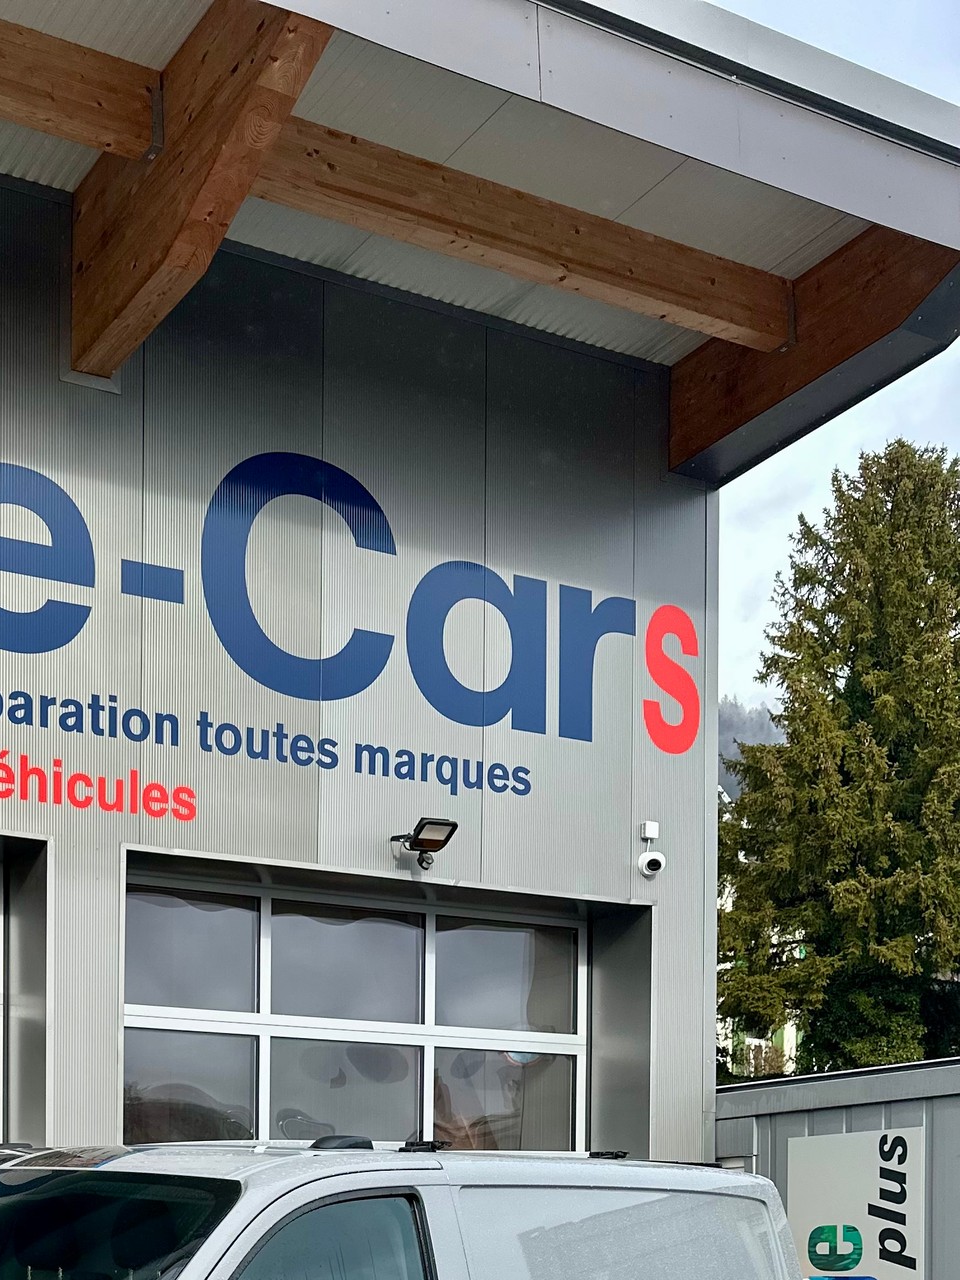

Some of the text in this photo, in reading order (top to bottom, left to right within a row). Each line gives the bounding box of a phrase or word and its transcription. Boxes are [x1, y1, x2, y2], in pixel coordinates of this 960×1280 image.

[197, 712, 339, 770] toutes
[355, 743, 531, 796] marques
[867, 1133, 917, 1271] plus
